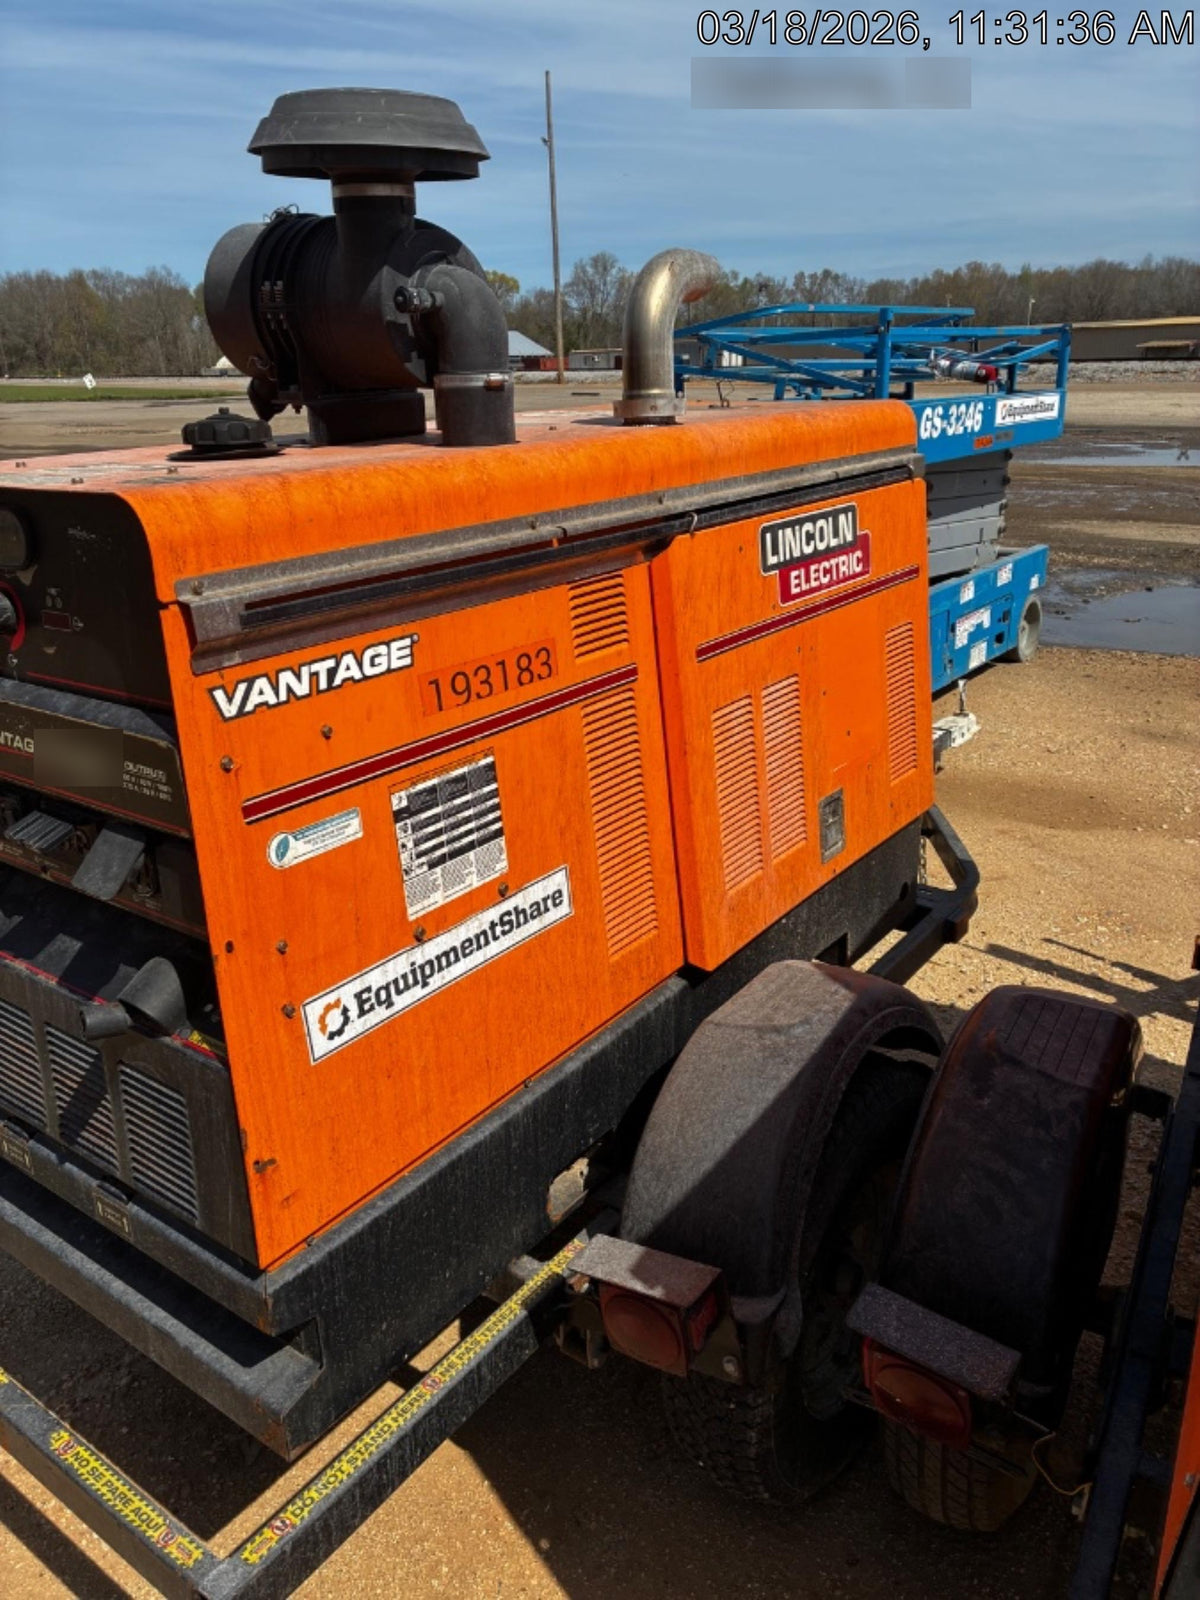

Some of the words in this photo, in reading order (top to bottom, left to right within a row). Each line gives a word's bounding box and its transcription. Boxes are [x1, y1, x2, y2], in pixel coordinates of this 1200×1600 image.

[920, 402, 984, 440] GS-3246
[765, 512, 853, 566] LINCOLN
[790, 550, 864, 595] ELECTRIC
[427, 646, 554, 712] 193183
[353, 886, 565, 1020] EquipmentShare
[71, 1450, 90, 1469] NO
[87, 1466, 104, 1482] SE
[101, 1478, 133, 1510] PARE
[290, 1495, 315, 1519] DO
[316, 1465, 349, 1496] NOT
[348, 1423, 392, 1467] STAND
[390, 1391, 427, 1424] HERE
